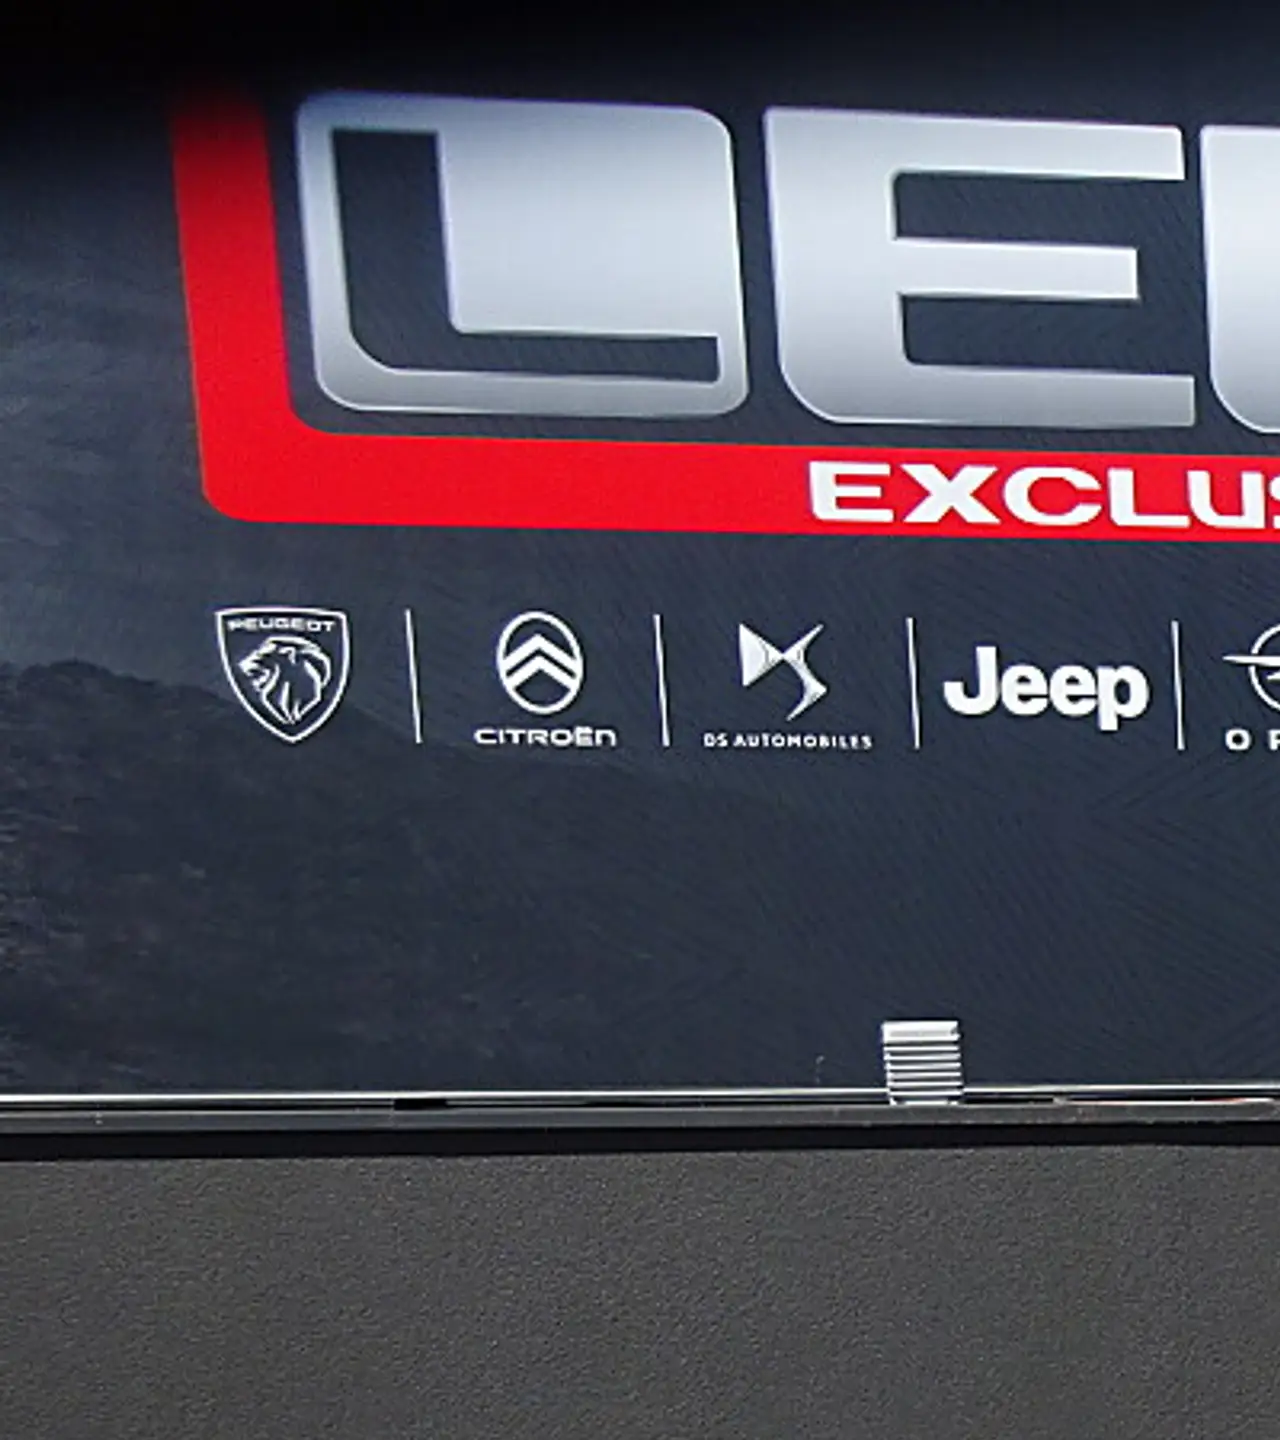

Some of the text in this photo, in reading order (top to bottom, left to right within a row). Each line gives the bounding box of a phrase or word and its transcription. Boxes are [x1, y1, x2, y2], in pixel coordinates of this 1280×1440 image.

[227, 616, 335, 633] PEUGEOT
[942, 644, 1150, 732] Jeep
[703, 732, 873, 750] DS AUTOMOBILES
